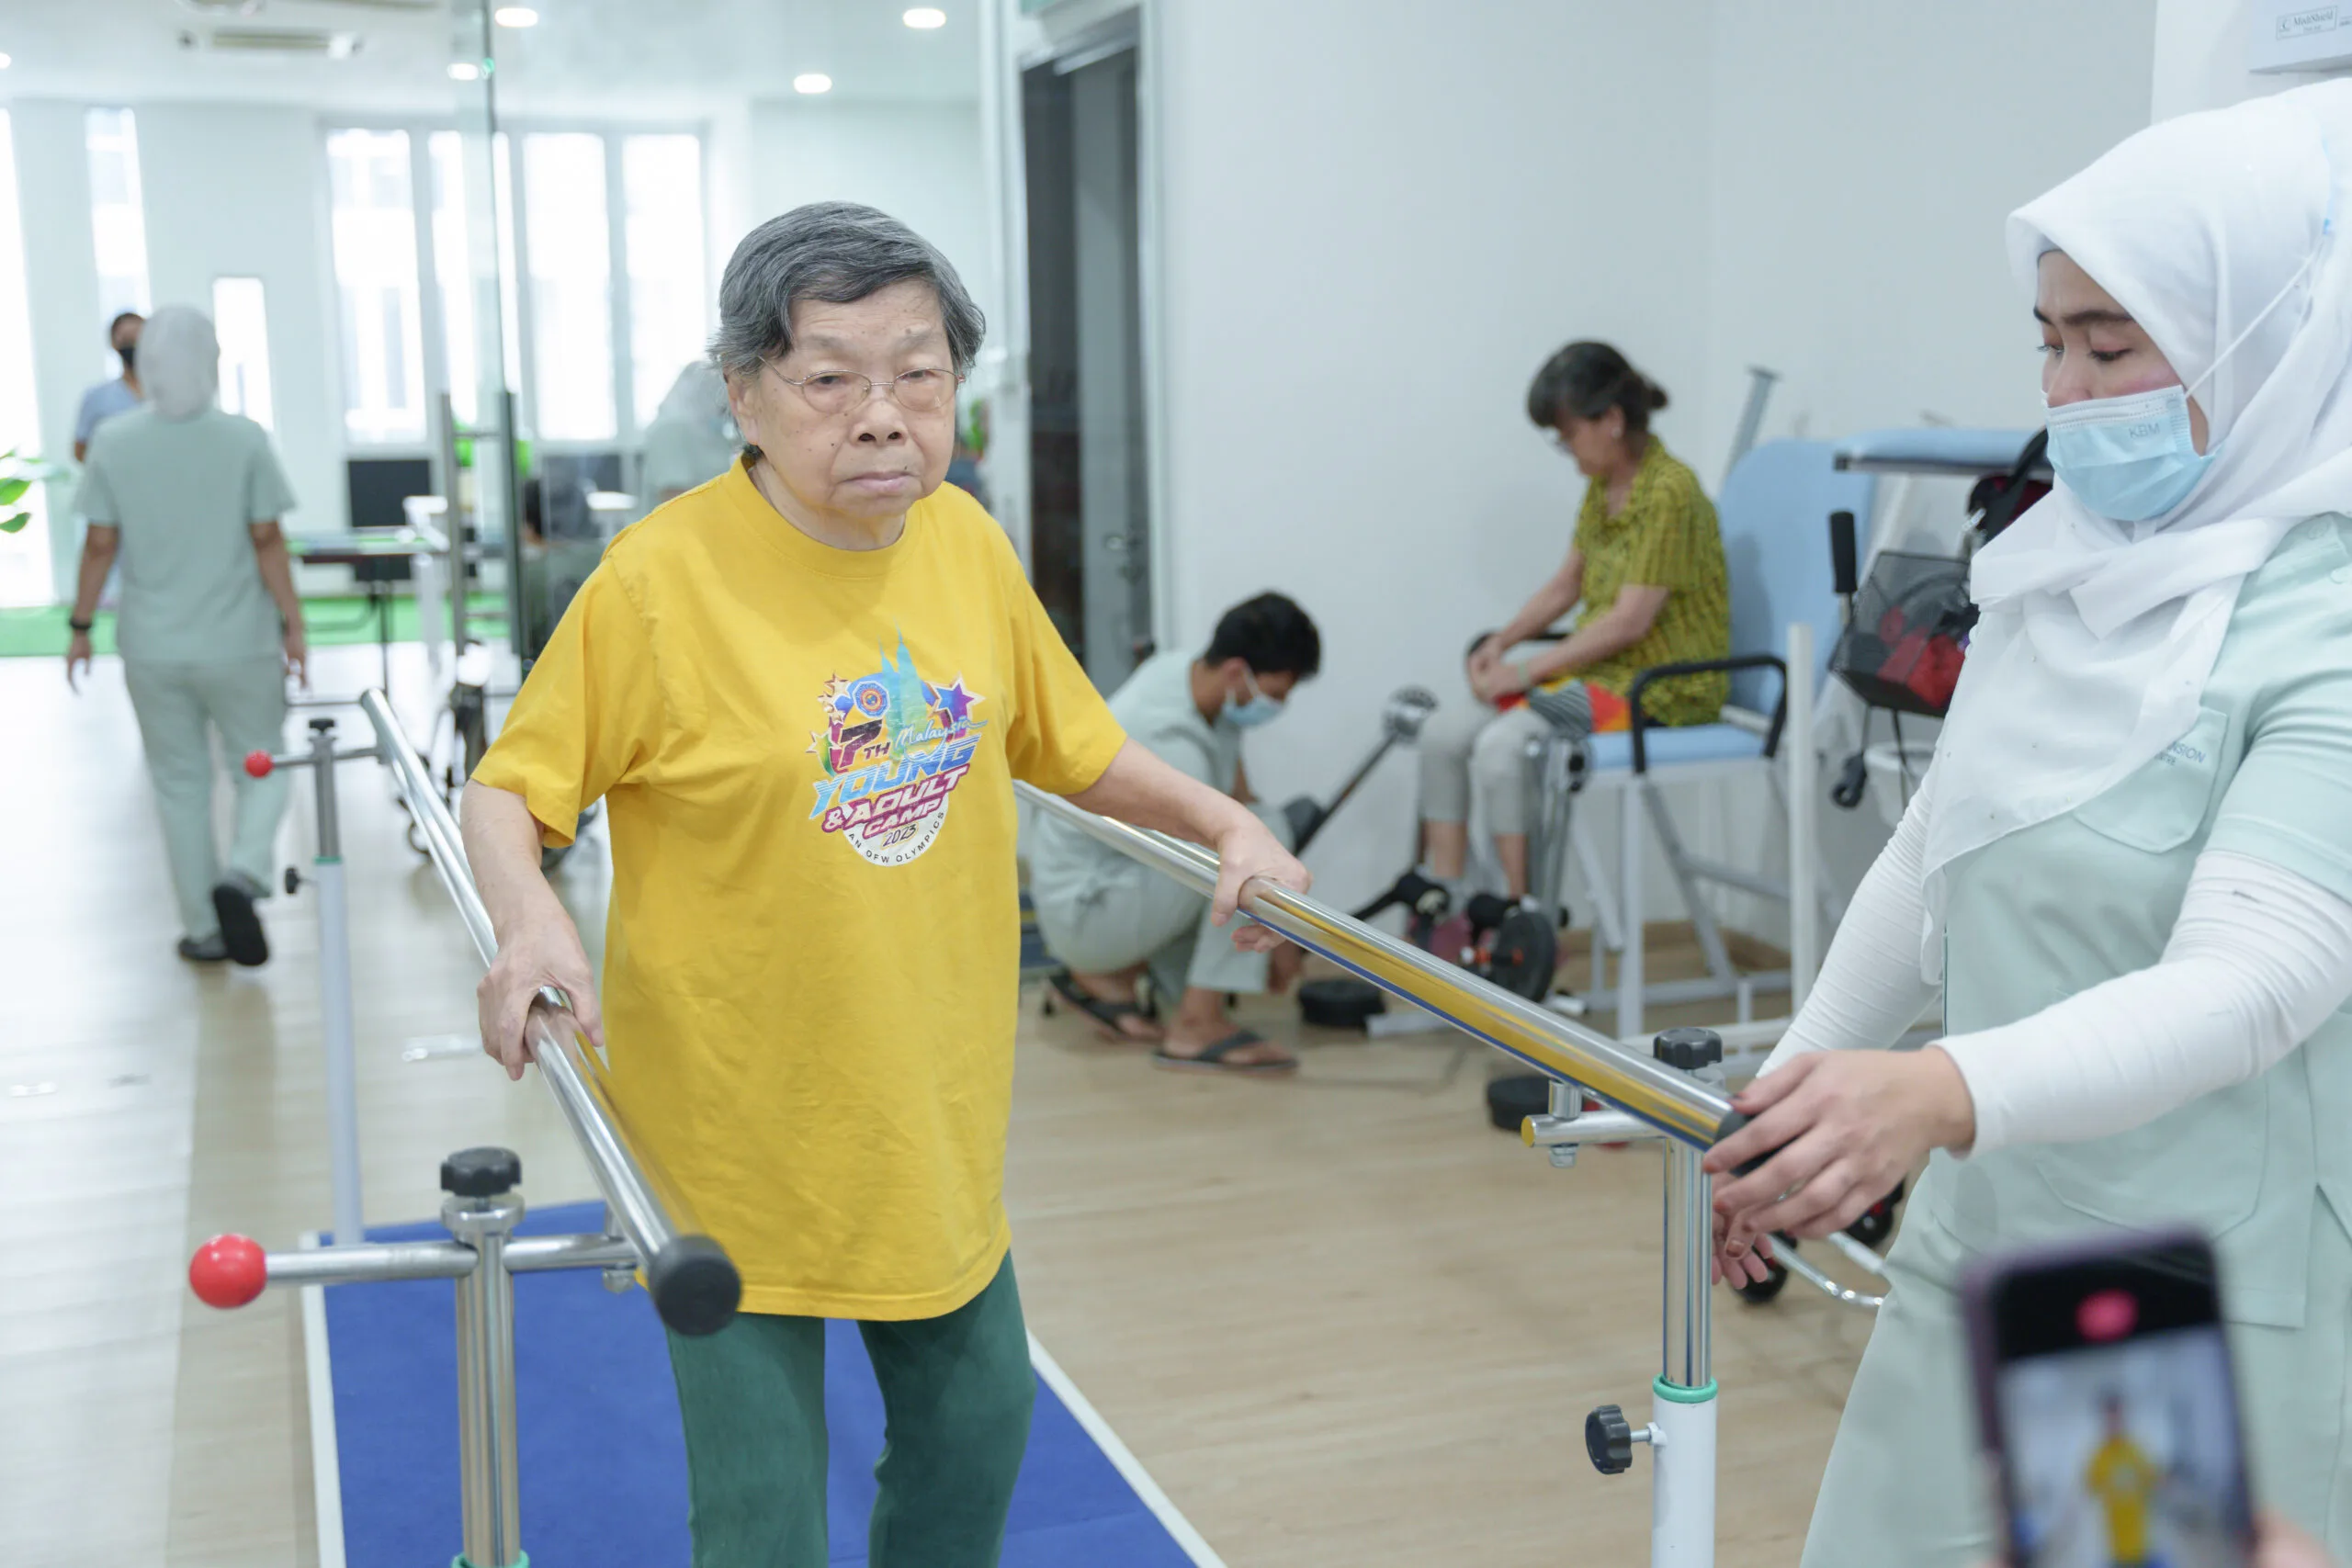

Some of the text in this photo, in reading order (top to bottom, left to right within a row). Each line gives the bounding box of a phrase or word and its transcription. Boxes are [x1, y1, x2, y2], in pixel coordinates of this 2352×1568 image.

[2128, 423, 2161, 438] KBM
[893, 716, 989, 761] Malaysia
[808, 733, 981, 819] YOUNG
[843, 763, 969, 828] ADULT
[849, 811, 944, 863] AN OFW OLYMPICS
[862, 797, 942, 839] CAMP
[882, 823, 917, 847] 2023
